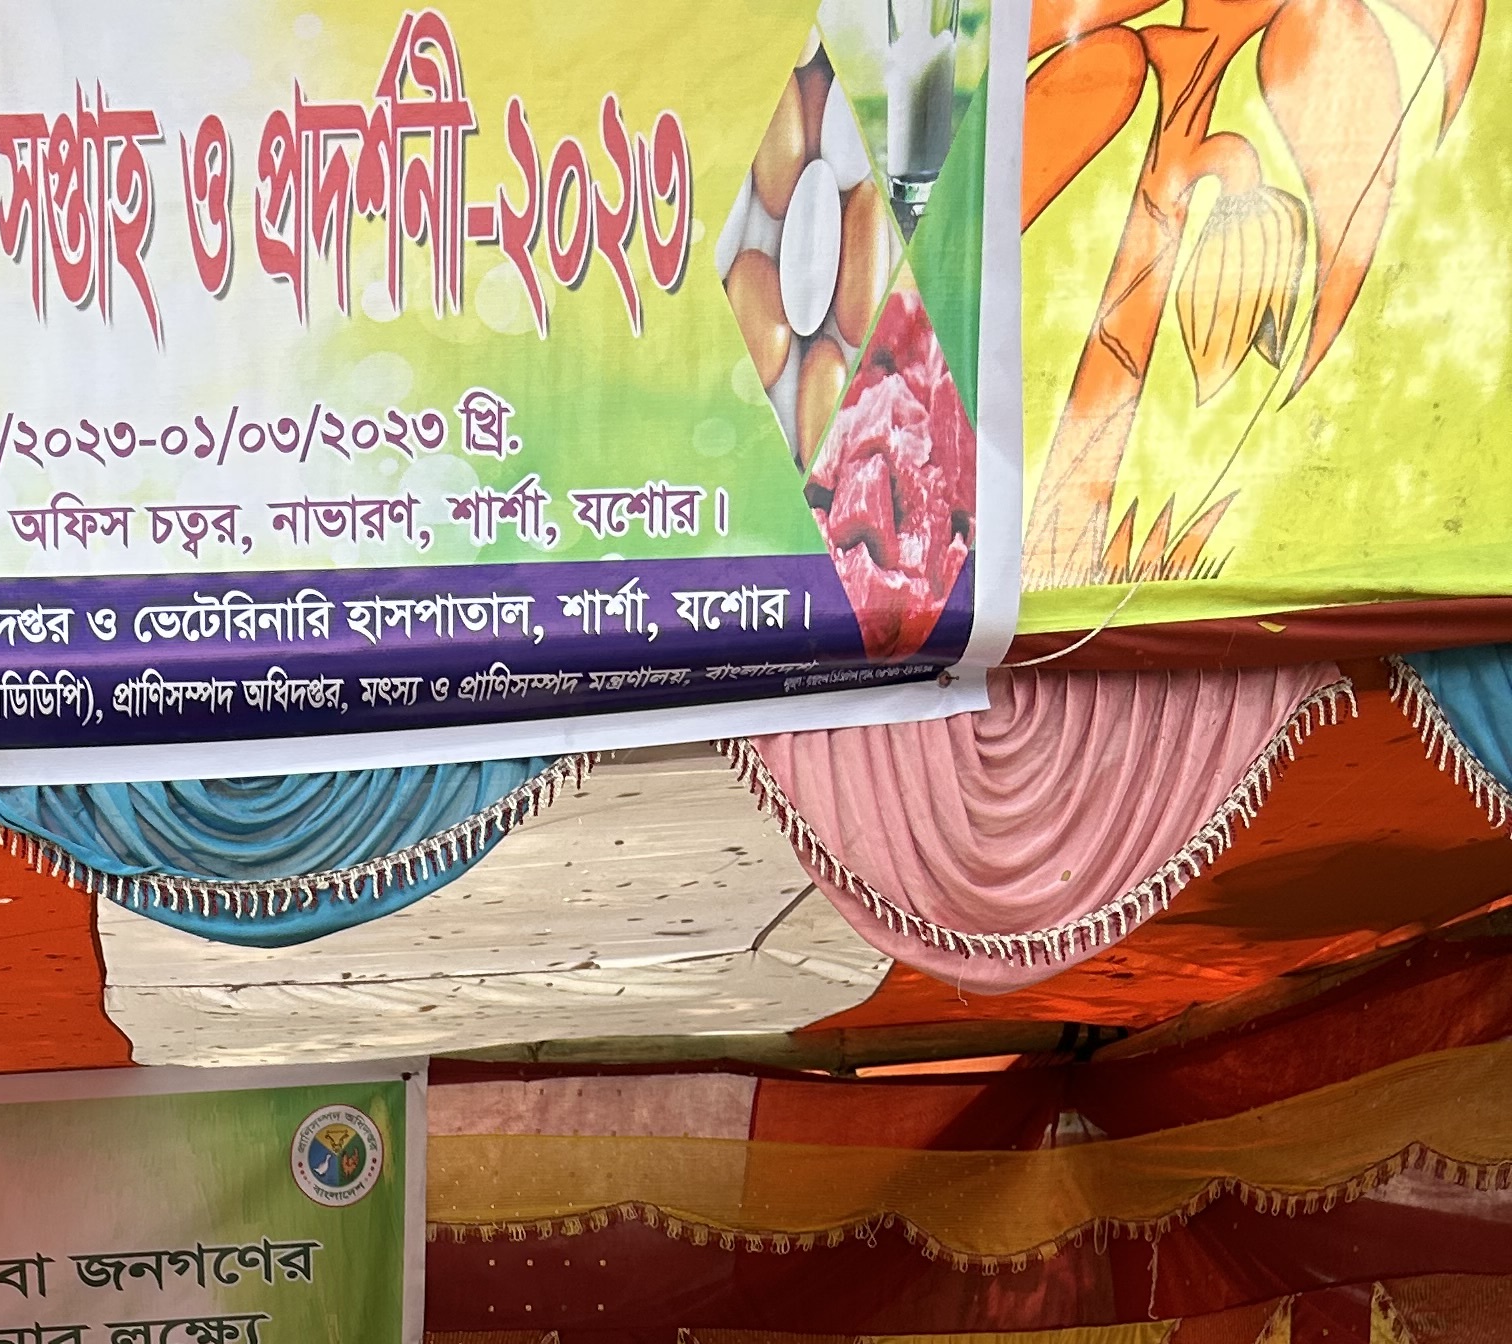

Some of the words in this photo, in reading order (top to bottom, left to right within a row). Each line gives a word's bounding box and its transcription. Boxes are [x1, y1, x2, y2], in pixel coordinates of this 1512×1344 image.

[181, 113, 232, 297] ও
[255, 11, 693, 340] প্রদর্শনী-২০২৩
[460, 392, 519, 457] খ্রি.
[8, 492, 137, 551] অফিস
[145, 503, 253, 559] চত্বর,
[267, 492, 431, 551] নাভারণ,
[446, 478, 557, 547] শার্শা,
[571, 484, 700, 535] যশোর
[87, 609, 118, 641] ও
[134, 588, 335, 643] ভেটেরিনারি
[343, 592, 544, 645] হাসপাতাল,
[557, 577, 659, 642] শার্শা,
[672, 584, 789, 632] যশোর
[113, 668, 237, 721] প্রাণিসম্পদ
[241, 665, 349, 715] অধিদপ্তর,
[359, 677, 424, 707] মৎস্য
[430, 679, 450, 702] ও
[457, 662, 582, 703] প্রাণিসম্পদ
[68, 1236, 322, 1291] জনগণের
